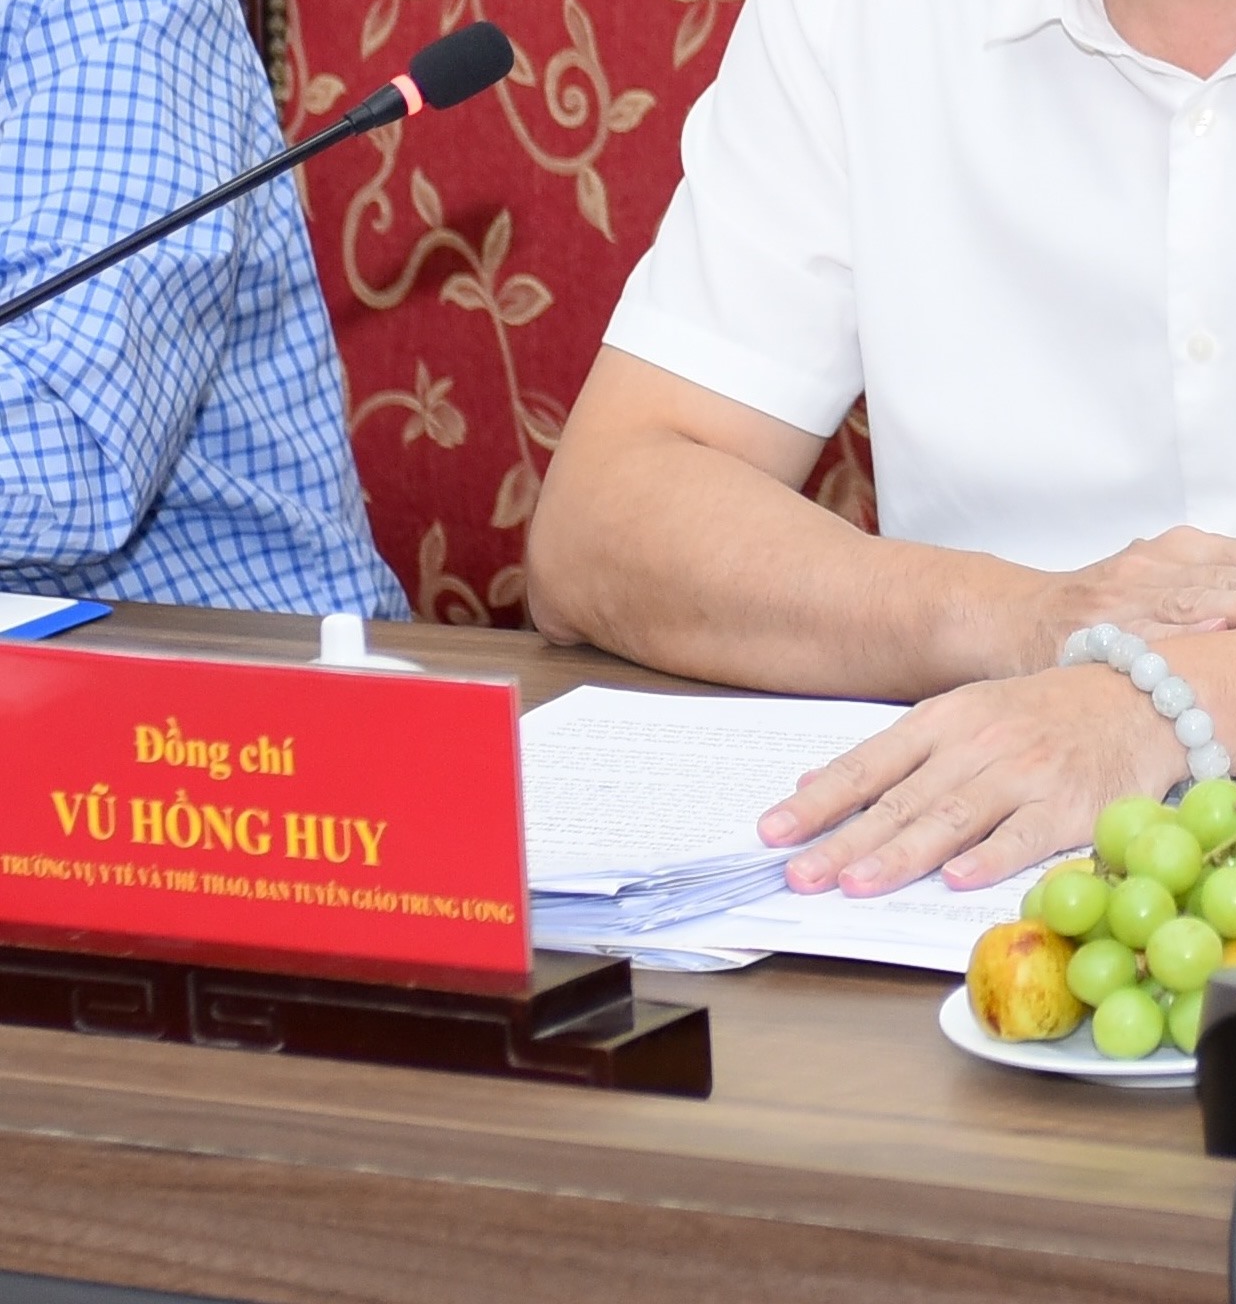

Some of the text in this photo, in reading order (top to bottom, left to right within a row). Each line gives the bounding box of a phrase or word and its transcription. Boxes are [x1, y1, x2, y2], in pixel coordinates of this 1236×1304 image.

[133, 716, 294, 781] Đồng chí
[51, 782, 388, 867] VŨ HỒNG HUY
[73, 861, 98, 887] VỤ
[100, 863, 111, 884] Y
[254, 877, 290, 902] BAN
[292, 879, 350, 908] TUYÊN
[352, 884, 398, 913] GIÁO
[400, 892, 460, 919] TRUNG
[462, 897, 515, 925] ƯƠNG
